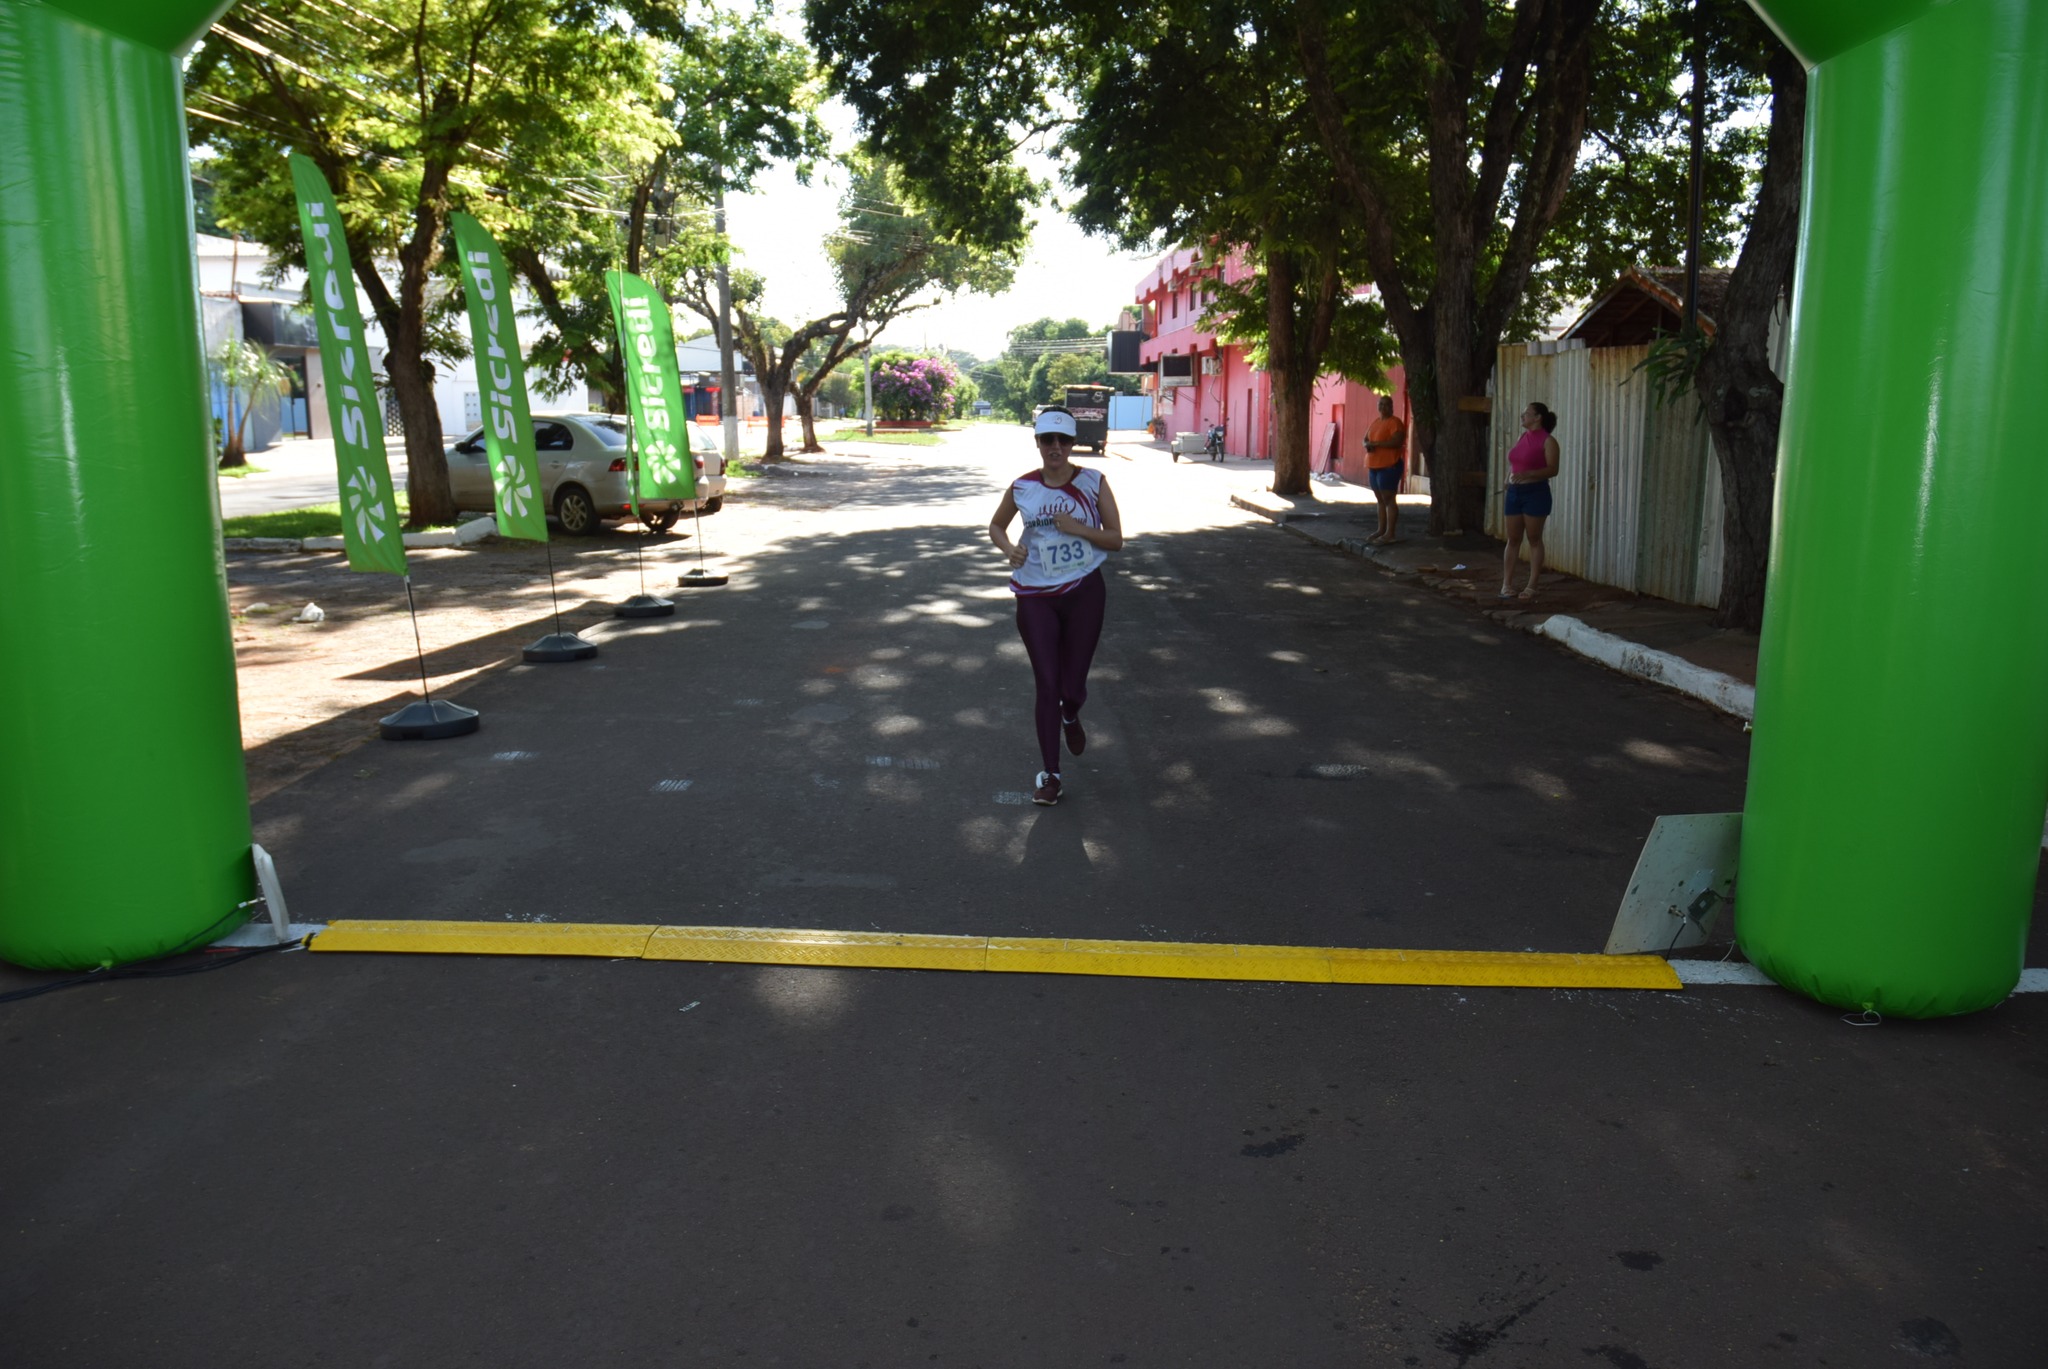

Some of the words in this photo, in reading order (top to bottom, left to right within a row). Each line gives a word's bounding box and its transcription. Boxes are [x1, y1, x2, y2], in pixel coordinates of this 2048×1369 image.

[468, 251, 518, 444] Sicredi
[623, 295, 670, 432] Sicredi
[1046, 540, 1085, 565] 733
